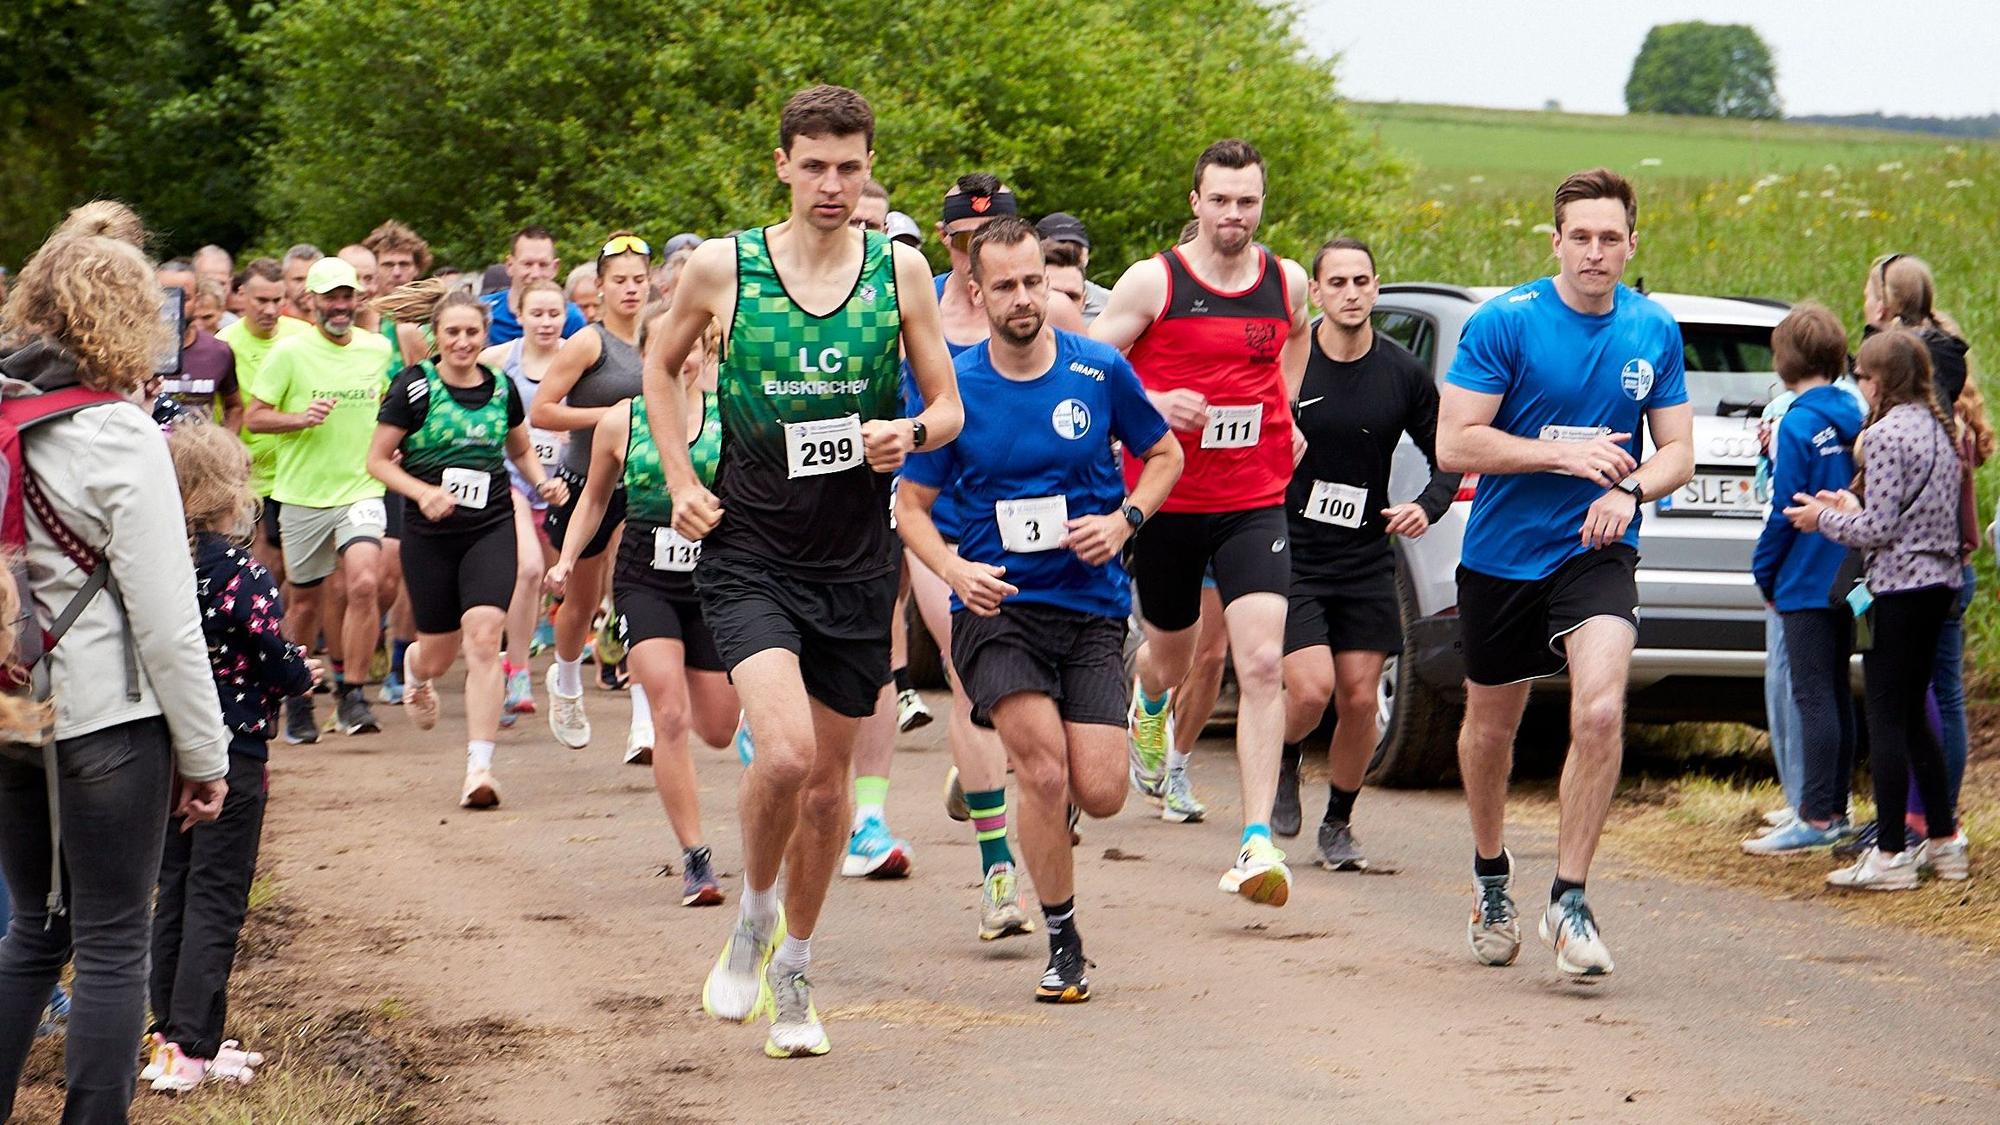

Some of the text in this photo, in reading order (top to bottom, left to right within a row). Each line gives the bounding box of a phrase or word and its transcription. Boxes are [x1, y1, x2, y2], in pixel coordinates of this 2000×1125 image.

[798, 347, 843, 374] LC
[764, 378, 870, 396] EUSKIRCHEN
[1214, 420, 1251, 441] 111
[800, 437, 854, 467] 299
[449, 482, 479, 501] 211
[1685, 478, 1735, 504] SLE
[1319, 498, 1355, 520] 100
[1024, 519, 1041, 543] 3
